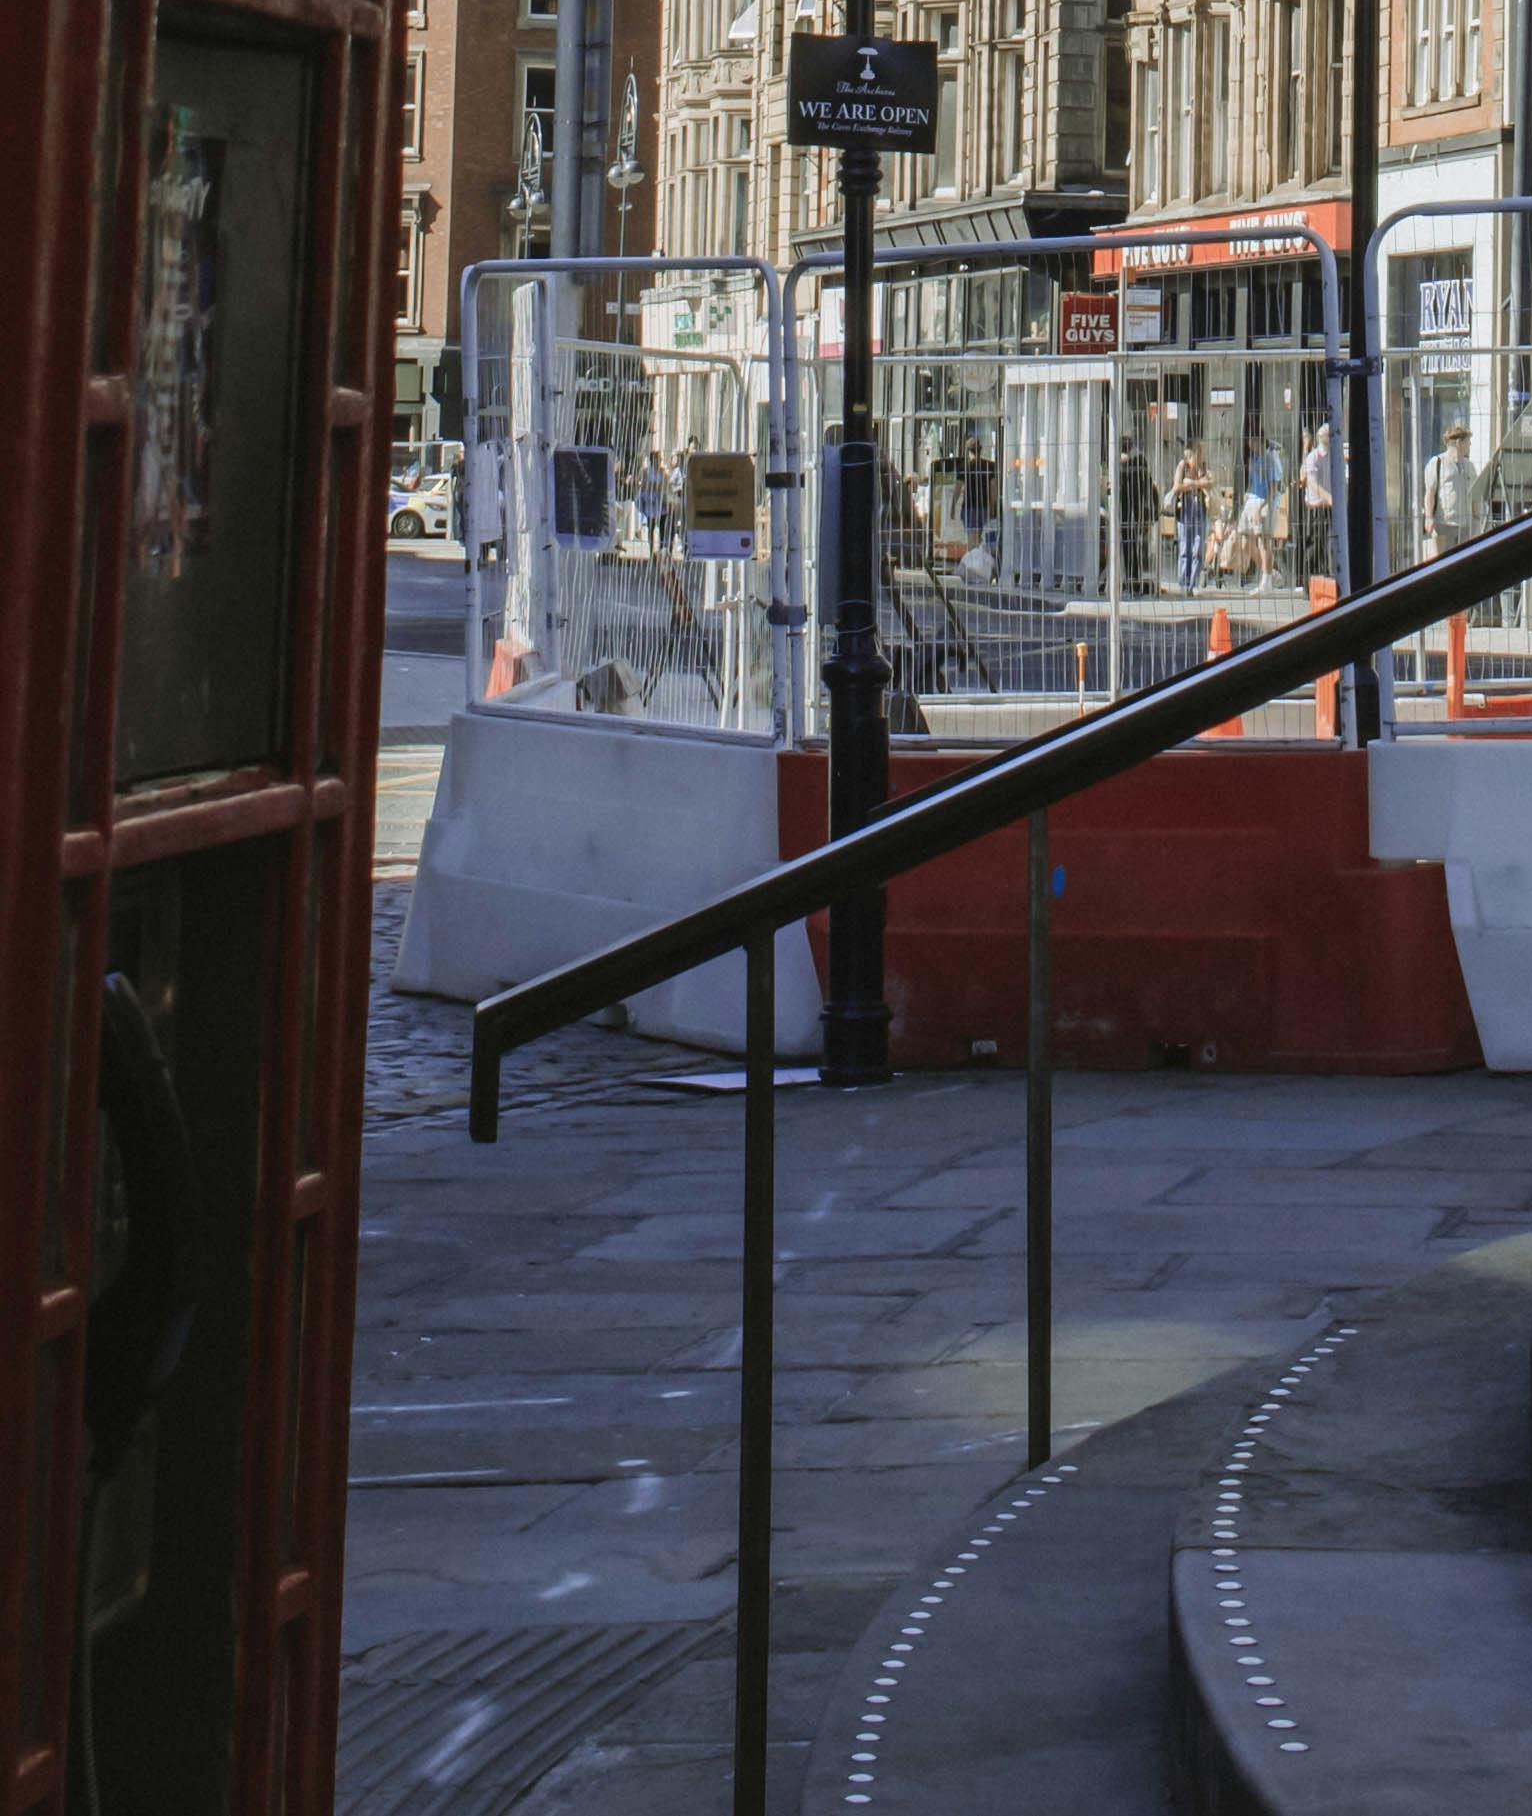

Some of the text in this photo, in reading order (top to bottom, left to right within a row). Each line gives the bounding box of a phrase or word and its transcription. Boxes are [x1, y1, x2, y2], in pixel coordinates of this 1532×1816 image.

[799, 100, 930, 125] WE ARE OPEN
[1070, 313, 1110, 328] FIVE
[1065, 328, 1115, 343] GUYS
